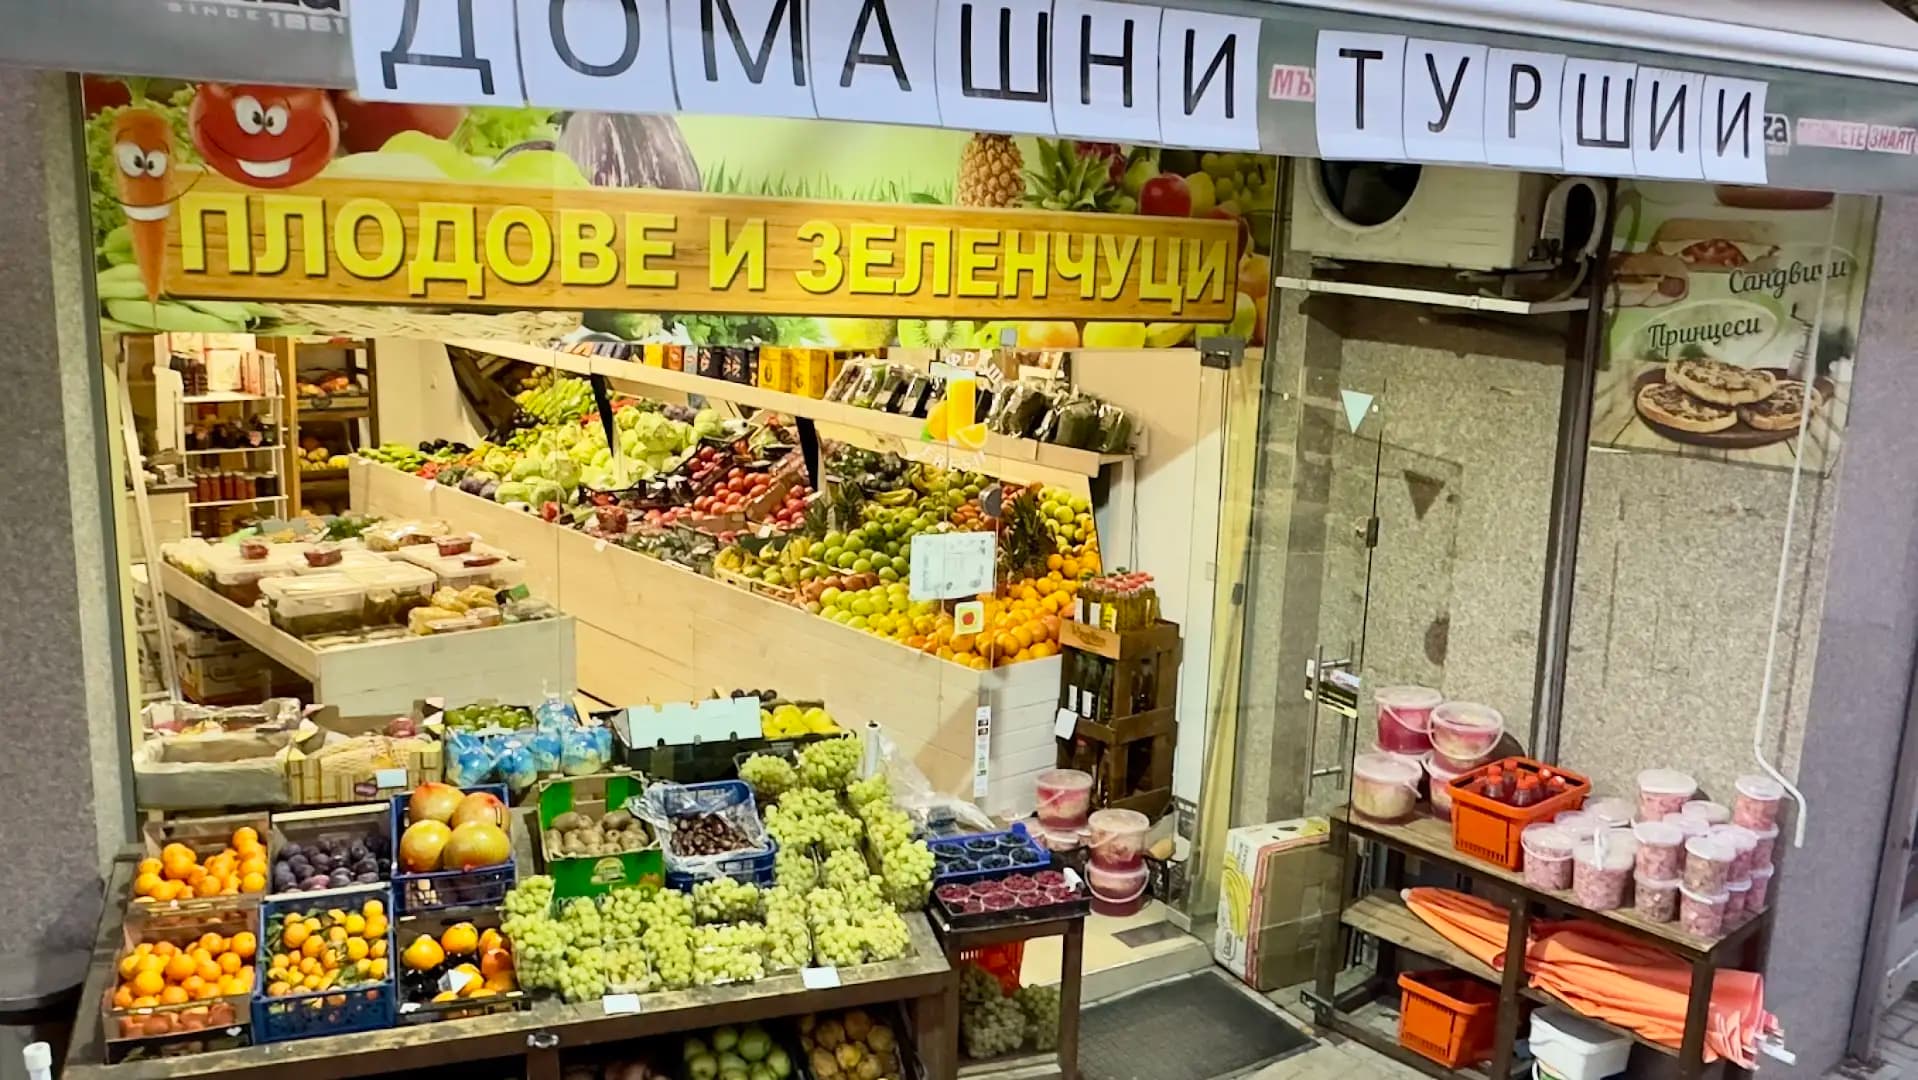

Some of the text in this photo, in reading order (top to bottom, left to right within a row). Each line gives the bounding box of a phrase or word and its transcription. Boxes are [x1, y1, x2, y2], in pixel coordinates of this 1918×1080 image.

[167, 2, 261, 21] SINCE
[380, 0, 1752, 159] ДОМАШНИ ТУРШИИ
[178, 194, 1228, 314] ПЛОДОВЕ И ЗЕЛЕНЧУЦИ
[1647, 317, 1763, 357] Принцеси
